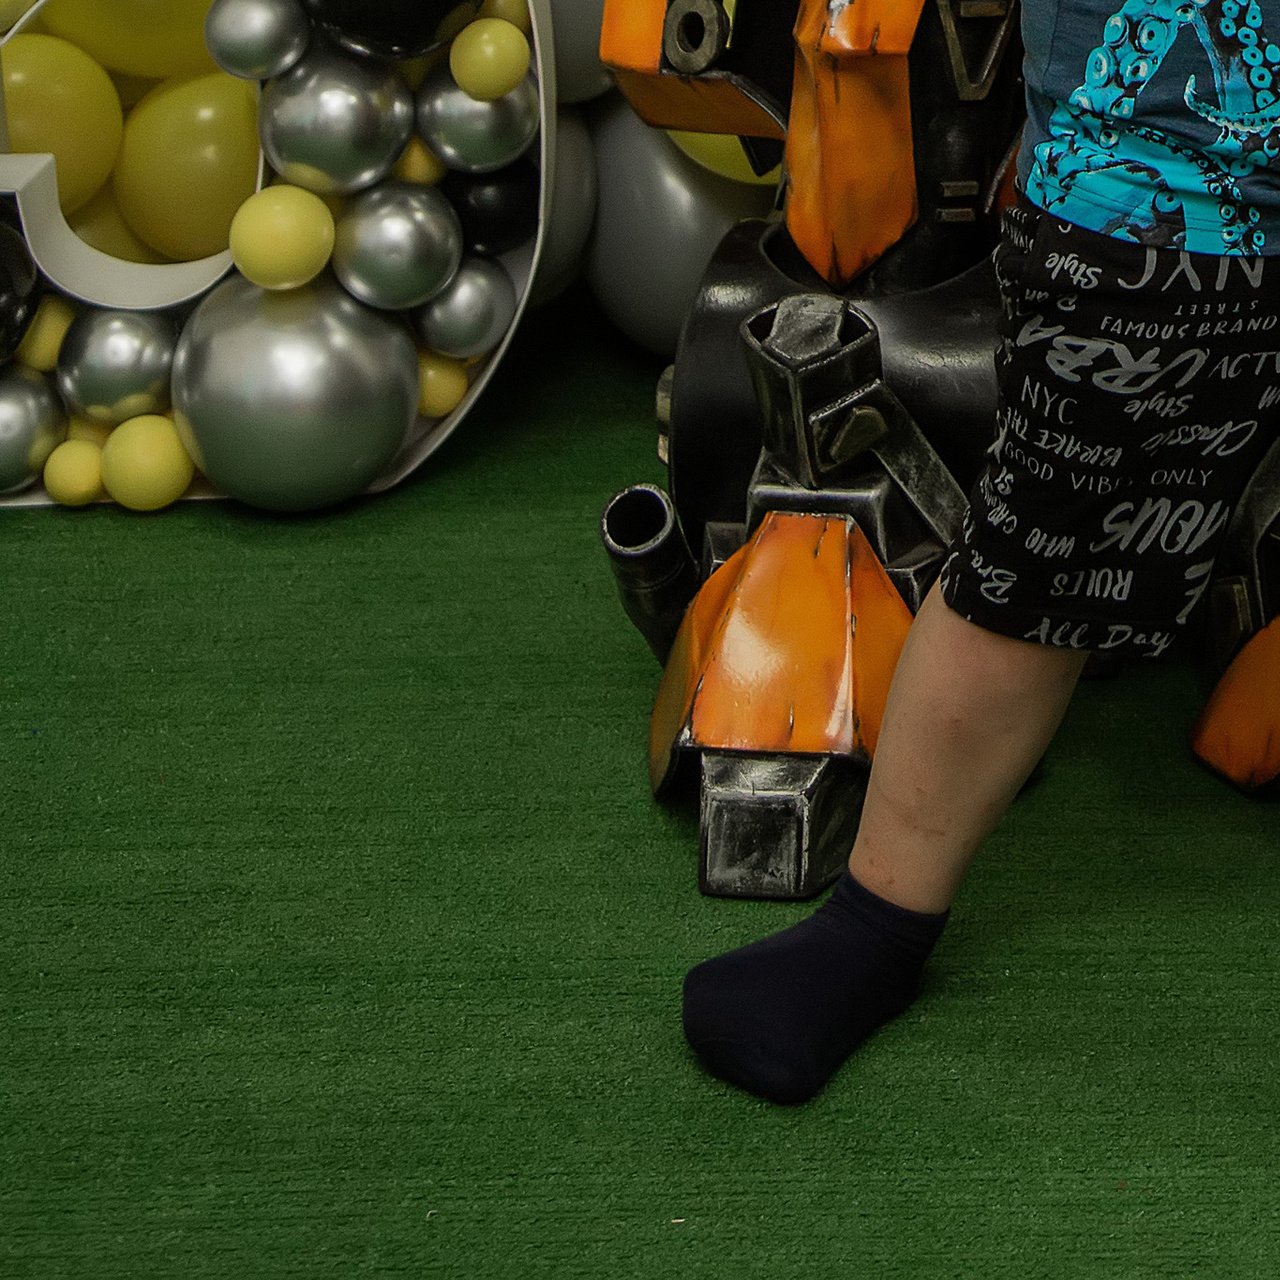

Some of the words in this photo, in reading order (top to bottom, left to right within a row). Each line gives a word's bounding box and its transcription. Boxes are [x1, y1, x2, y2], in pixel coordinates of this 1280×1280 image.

[1045, 252, 1102, 290] Style
[1174, 300, 1259, 316] STREET
[1100, 316, 1190, 340] FAMOUS
[1196, 315, 1278, 339] BRAND
[1021, 374, 1078, 425] NYC
[1004, 440, 1054, 481] GOOD
[1150, 468, 1214, 487] ONLY
[1033, 428, 1123, 468] BRAKE
[1024, 527, 1076, 559] WHO
[1097, 624, 1176, 658] Day
